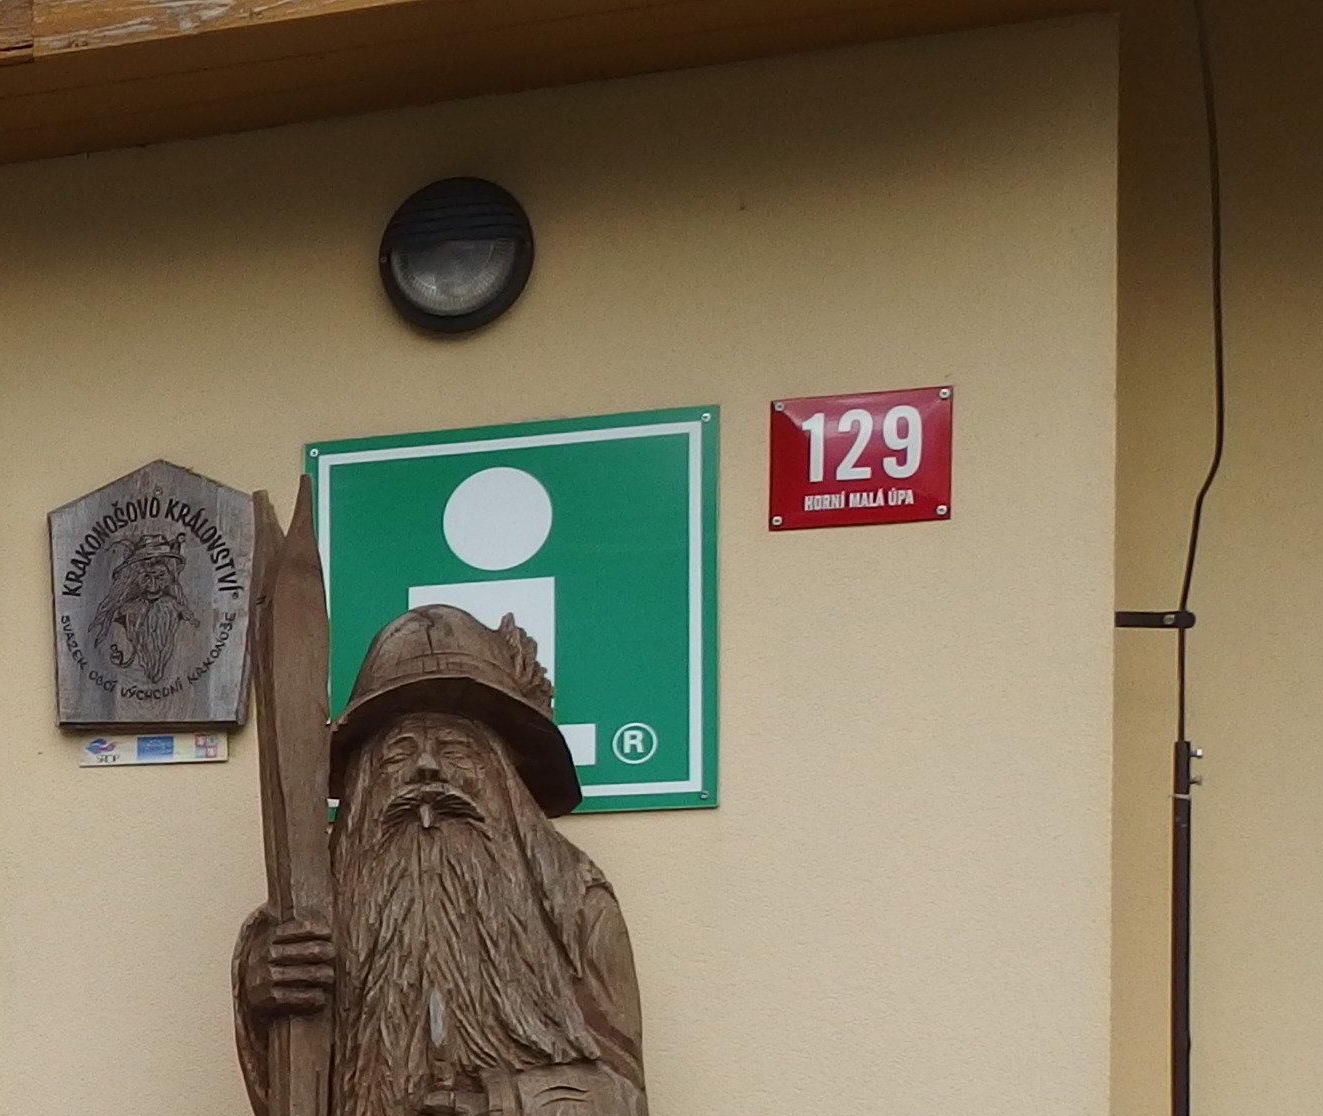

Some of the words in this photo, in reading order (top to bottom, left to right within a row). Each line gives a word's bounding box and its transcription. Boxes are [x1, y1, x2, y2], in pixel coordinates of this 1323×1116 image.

[802, 405, 922, 483] 129
[805, 491, 845, 511] HORNÍ
[849, 488, 884, 508] MALÁ
[888, 487, 914, 506] ÚPA
[62, 497, 160, 596] KRAKONOŠOVO
[61, 615, 87, 670] SVAZEK
